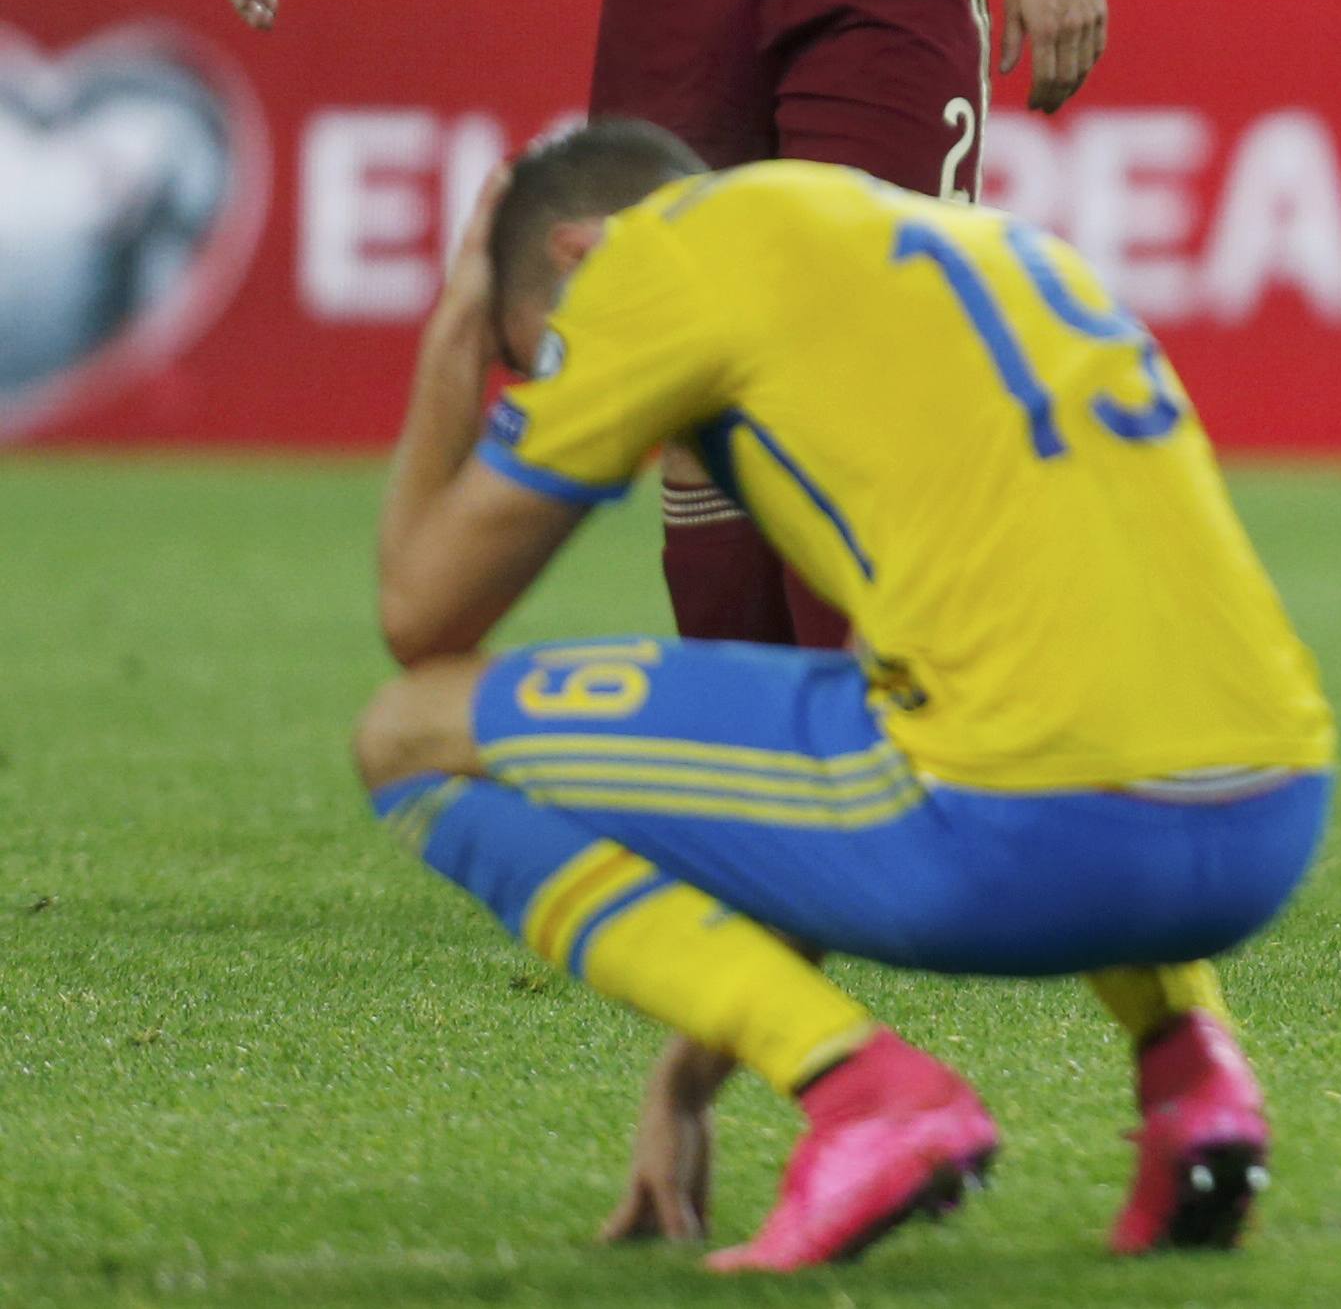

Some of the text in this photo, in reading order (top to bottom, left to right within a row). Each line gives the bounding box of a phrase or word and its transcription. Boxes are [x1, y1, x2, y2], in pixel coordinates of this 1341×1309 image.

[940, 97, 975, 204] 2
[888, 216, 1182, 461] 19
[516, 637, 663, 721] 19
